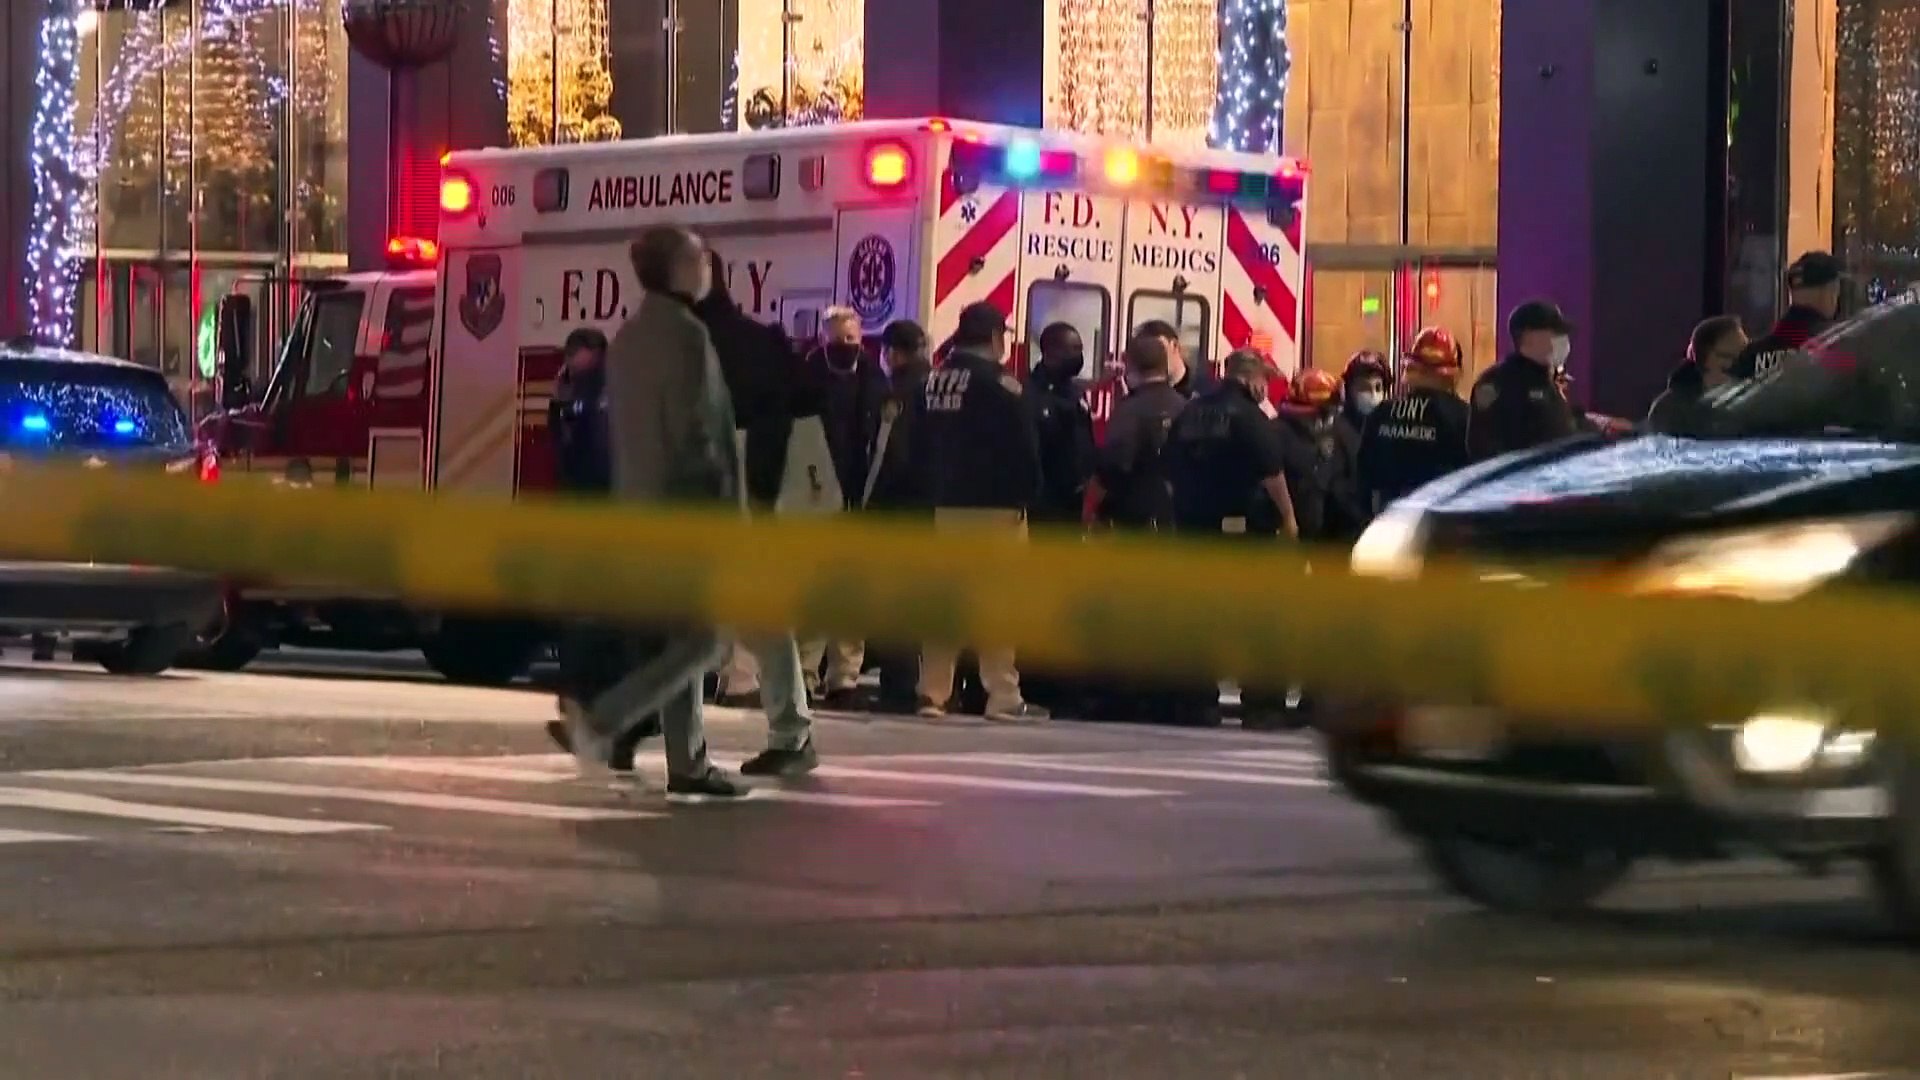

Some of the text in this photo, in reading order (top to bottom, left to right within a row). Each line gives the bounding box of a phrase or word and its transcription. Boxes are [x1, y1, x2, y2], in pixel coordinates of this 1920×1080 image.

[491, 169, 734, 212] 006 AMBULANCE
[1043, 190, 1204, 239] F.D. N.Y.
[1027, 232, 1217, 274] RESCUE MEDICS
[560, 267, 628, 321] F.D.
